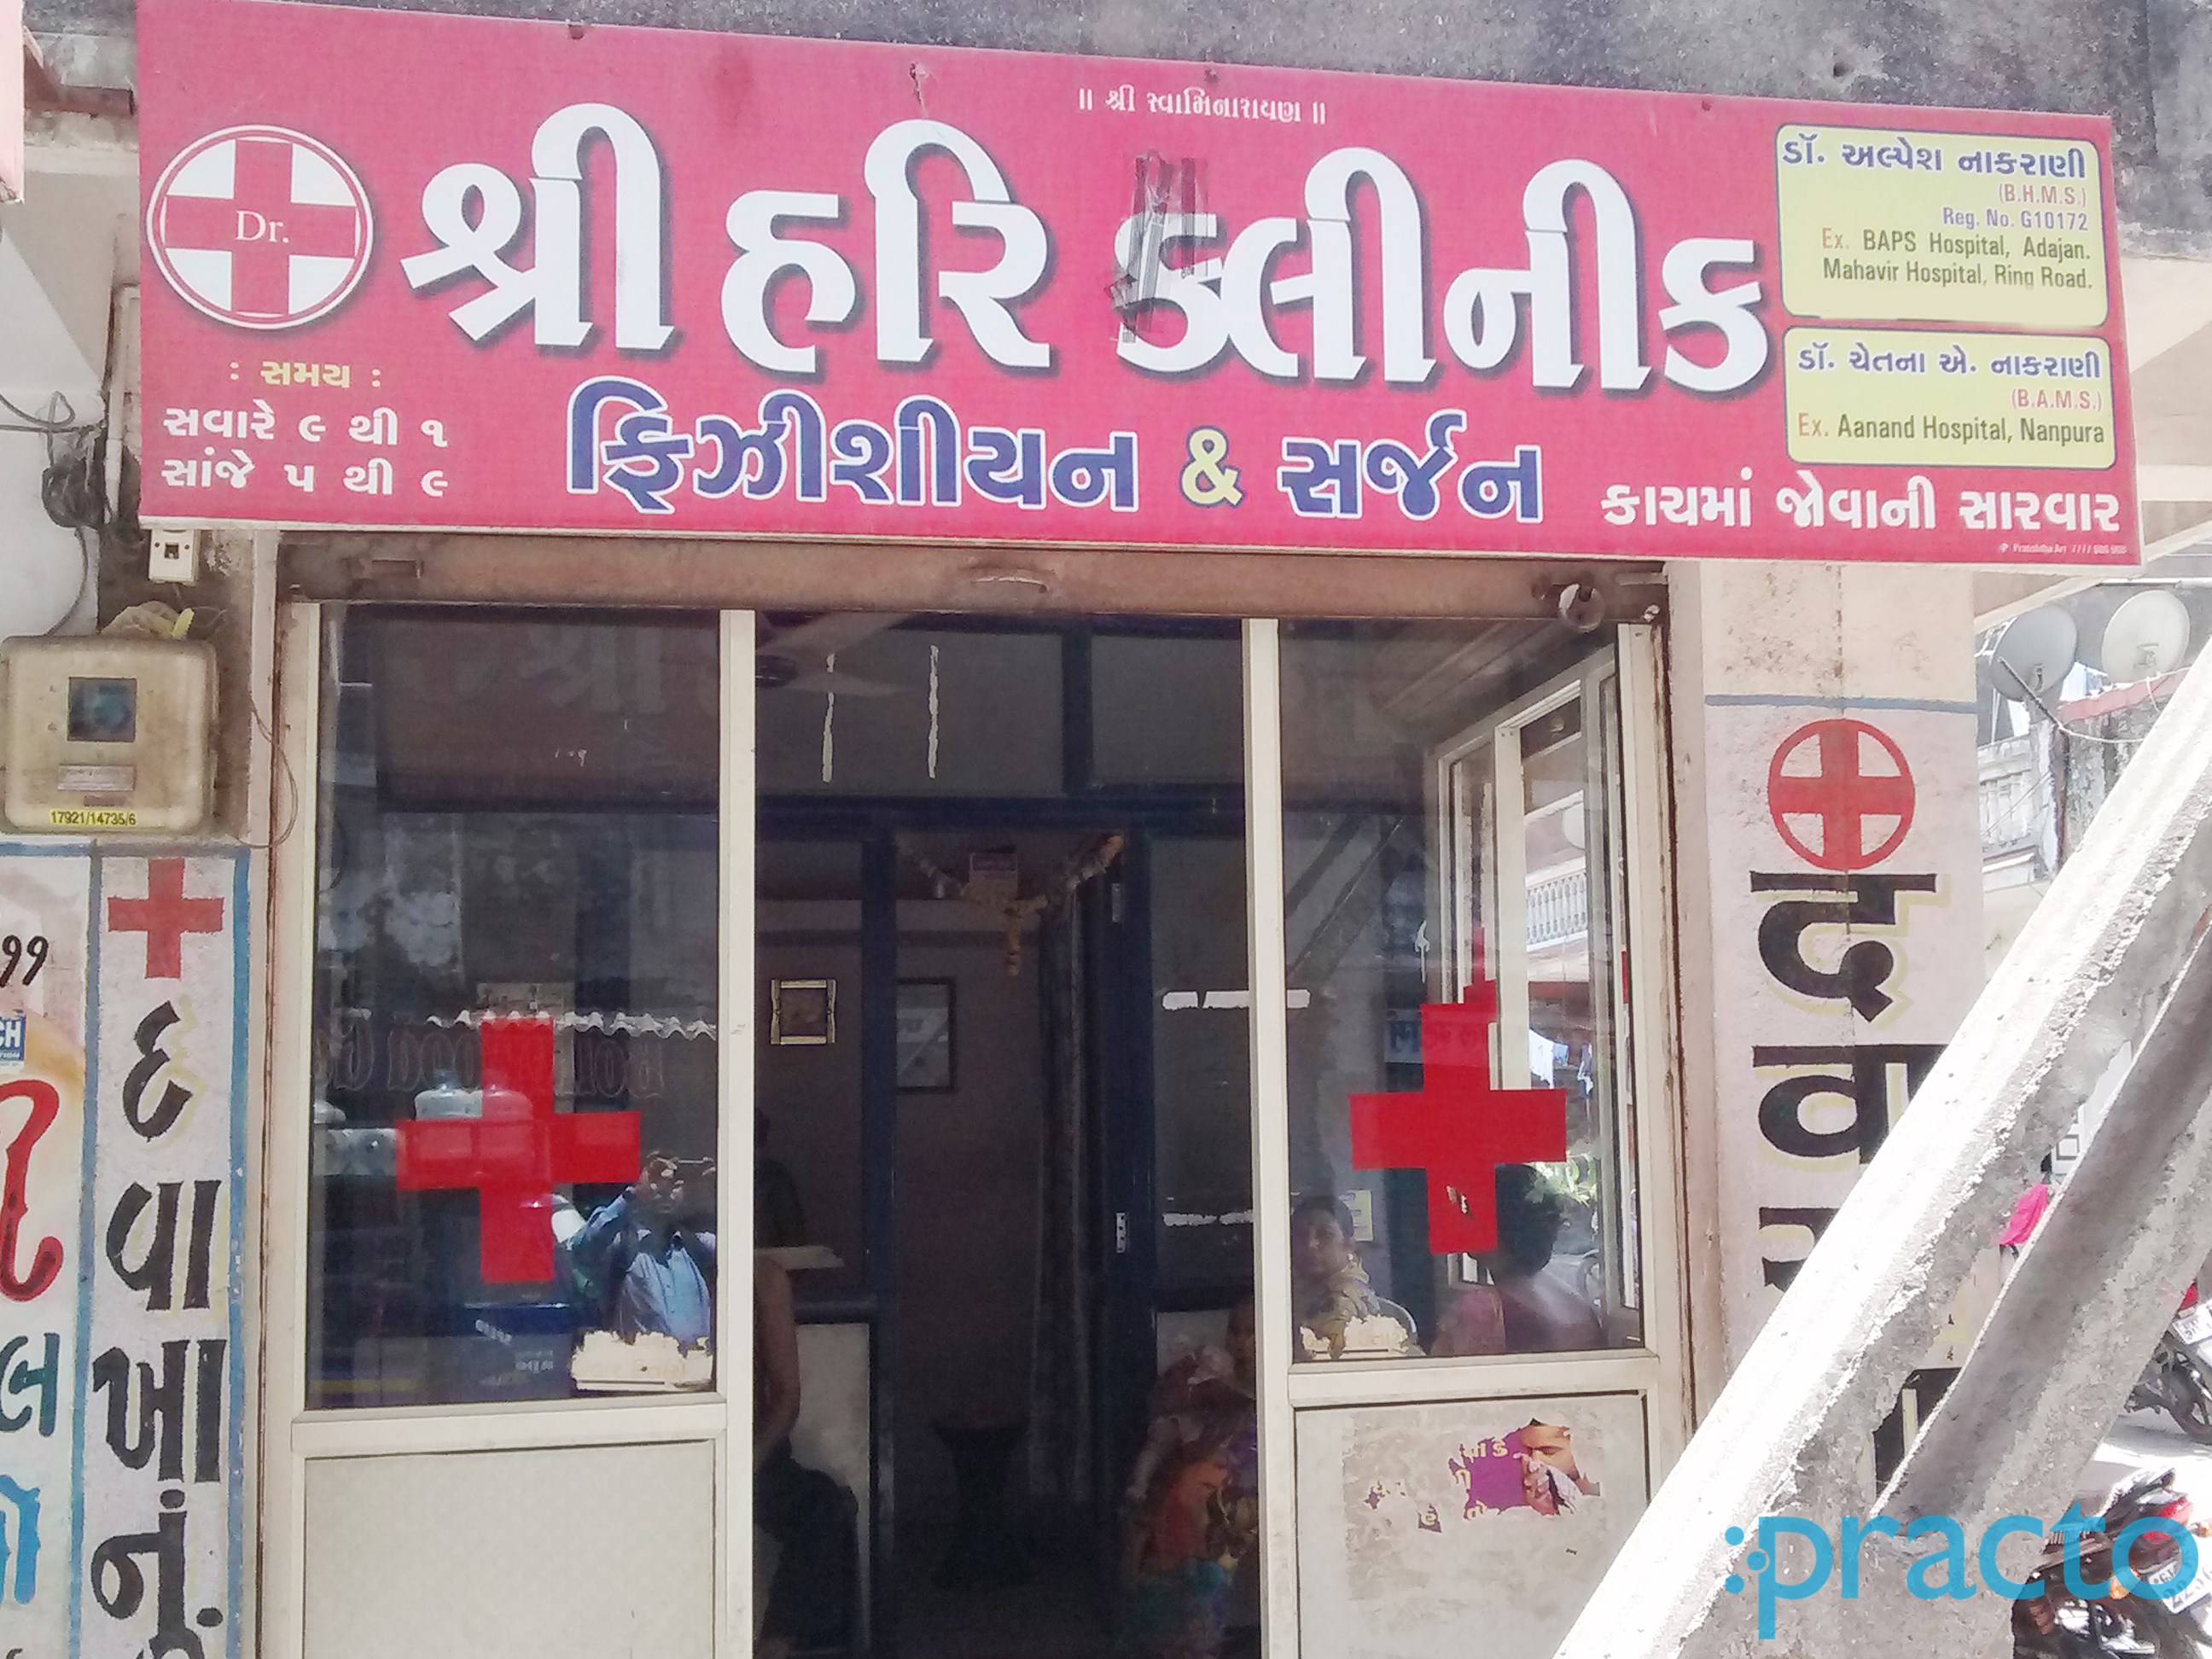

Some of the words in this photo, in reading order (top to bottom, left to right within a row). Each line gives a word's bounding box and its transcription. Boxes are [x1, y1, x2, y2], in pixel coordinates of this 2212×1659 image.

[1105, 84, 1135, 112] શ્રી
[1147, 86, 1301, 123] સ્વામિનારાયણ
[1782, 133, 1825, 165] ડૉ.
[1842, 137, 1942, 171] અલ્પેશ
[1958, 148, 2086, 178] નાકરાણી
[1999, 183, 2087, 207] (B.H.M.S.)
[236, 210, 289, 244] Dr.
[1942, 207, 1980, 229] Reg.
[1986, 210, 2014, 228] No.
[2021, 211, 2088, 230] G10172
[400, 102, 674, 351] શ્રી
[721, 119, 1051, 373] હરિ
[1821, 227, 1849, 249] Ex.
[1863, 229, 1917, 253] BAPS
[1930, 231, 2011, 259] Hospital,
[2023, 236, 2091, 264] Adajan.
[1823, 258, 1899, 282] Mahavir
[1906, 260, 1988, 288] Hospital,
[1994, 265, 2034, 289] Ring
[2040, 265, 2093, 289] Road.
[260, 360, 350, 388] સમય
[1798, 342, 1835, 372] ડૉ.
[1848, 342, 1925, 374] ચેતના
[1939, 344, 1976, 375] એ.
[1990, 351, 2100, 379] નાકરાણી
[2011, 388, 2103, 413] (B.A.M.S.)
[163, 399, 276, 439] સવારે
[298, 415, 326, 442] ૯
[348, 407, 398, 445] થી
[421, 420, 448, 447] ૧
[1798, 412, 1829, 438] Ex.
[1837, 414, 1915, 440] Aanand
[1923, 416, 2012, 445] Hospital,
[2020, 418, 2104, 447] Nanpura
[567, 376, 1139, 515] ફિઝીશીયન
[1180, 425, 1243, 509] &
[1278, 409, 1543, 522] સર્જન
[160, 446, 255, 488] સાંજે
[342, 457, 393, 495] થી
[421, 470, 448, 497] ૯
[1600, 466, 1752, 527] કાયમાં
[1776, 469, 1936, 530] જોવાની
[1959, 489, 2121, 533] સારવાર
[50, 810, 137, 826] 17921/14735/6
